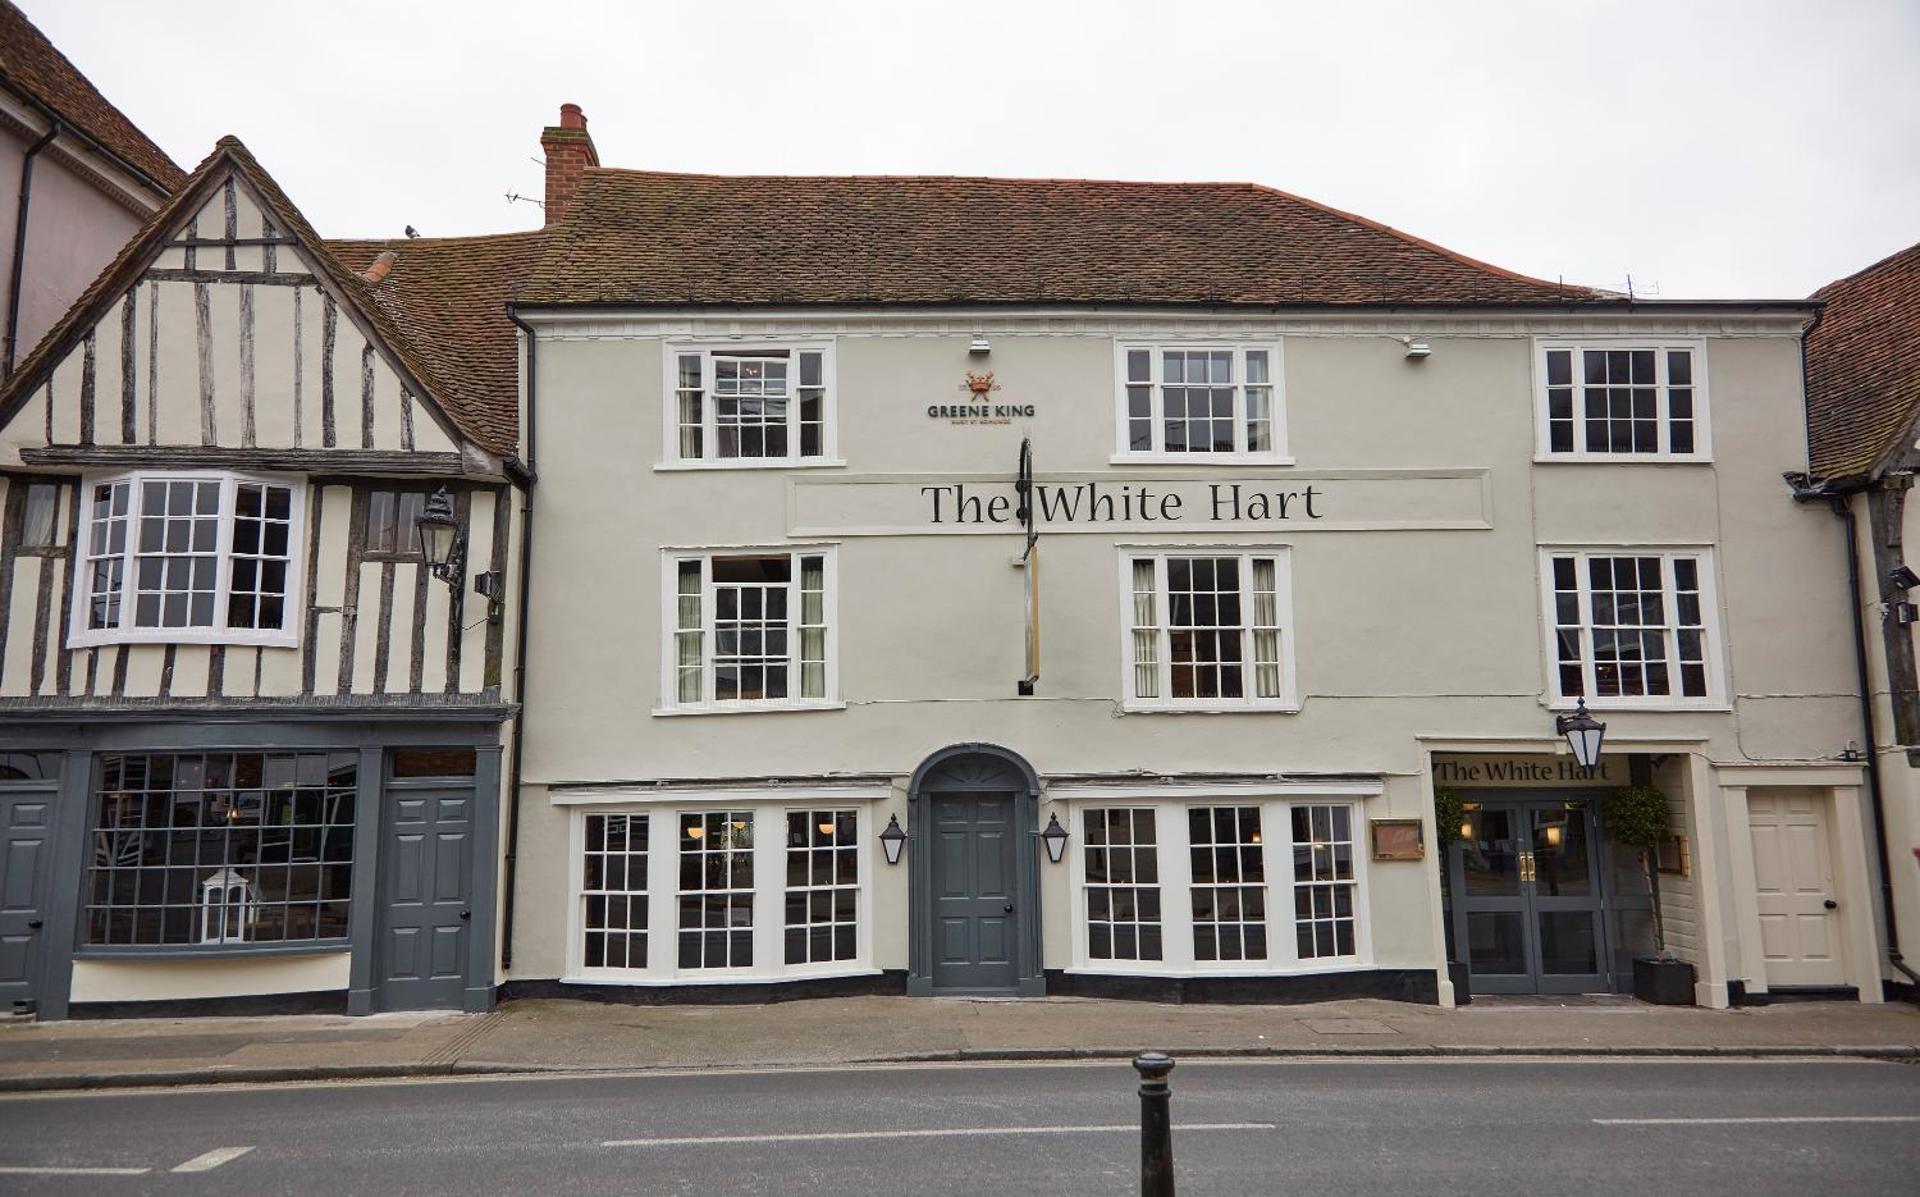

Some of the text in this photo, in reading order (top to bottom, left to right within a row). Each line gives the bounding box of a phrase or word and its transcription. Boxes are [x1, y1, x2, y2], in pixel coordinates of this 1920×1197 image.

[927, 404, 1035, 418] GREENE KING
[921, 482, 1323, 523] The White Hart
[1437, 760, 1611, 781] The White Hart
